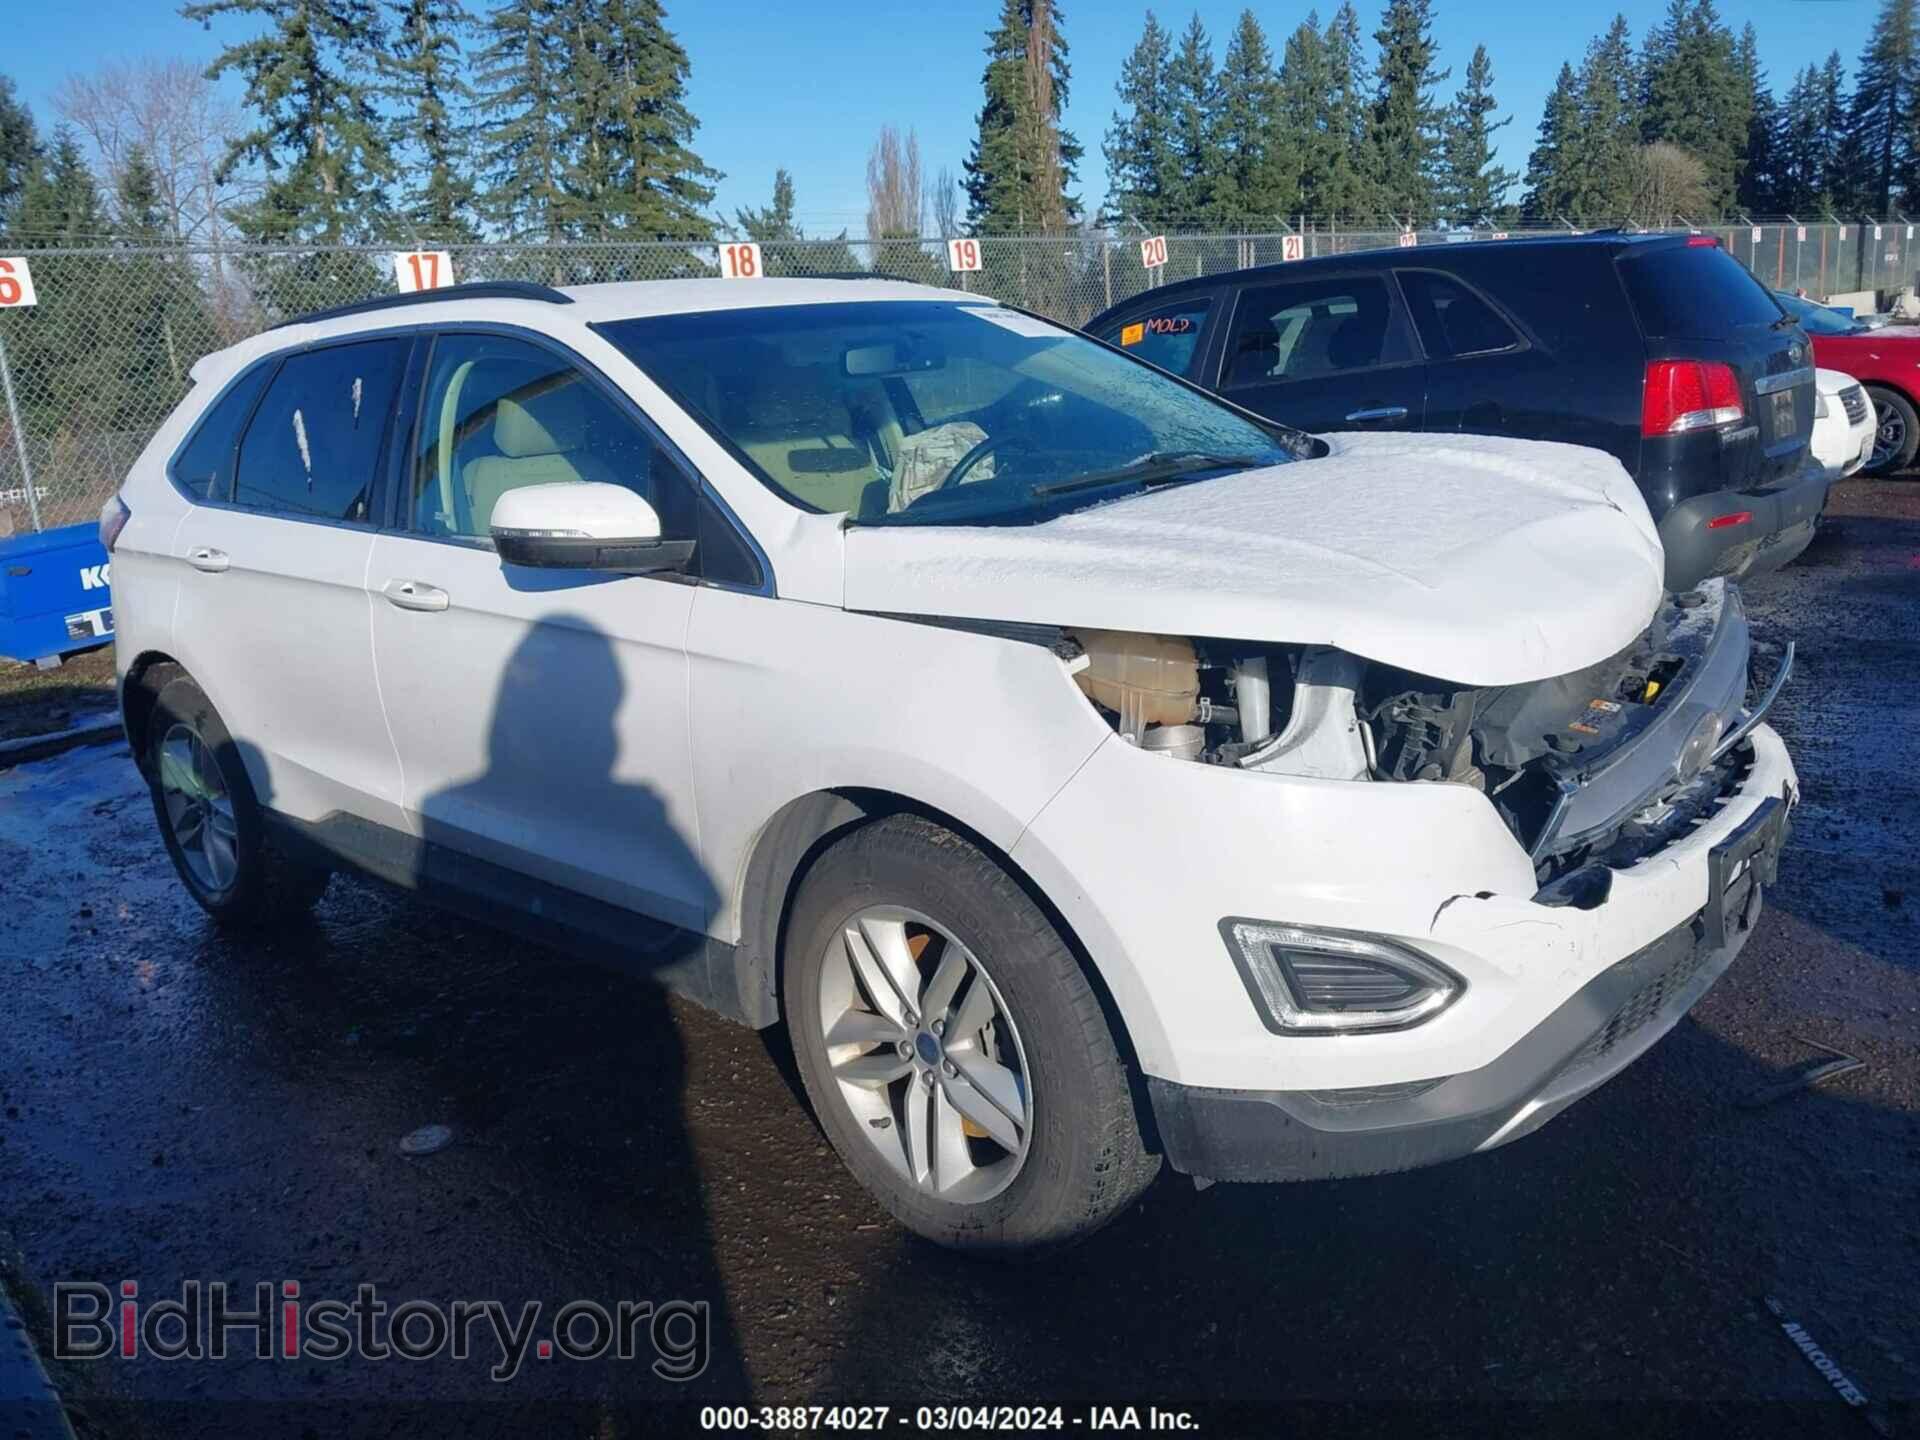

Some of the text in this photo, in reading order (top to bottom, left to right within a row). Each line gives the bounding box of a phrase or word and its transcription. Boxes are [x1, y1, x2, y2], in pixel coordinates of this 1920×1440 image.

[727, 245, 755, 277] 18
[954, 241, 977, 269] 19
[1144, 238, 1165, 266] 20
[1286, 237, 1301, 259] 21
[408, 254, 438, 292] 17
[1781, 1322, 1868, 1406] ANACORTES
